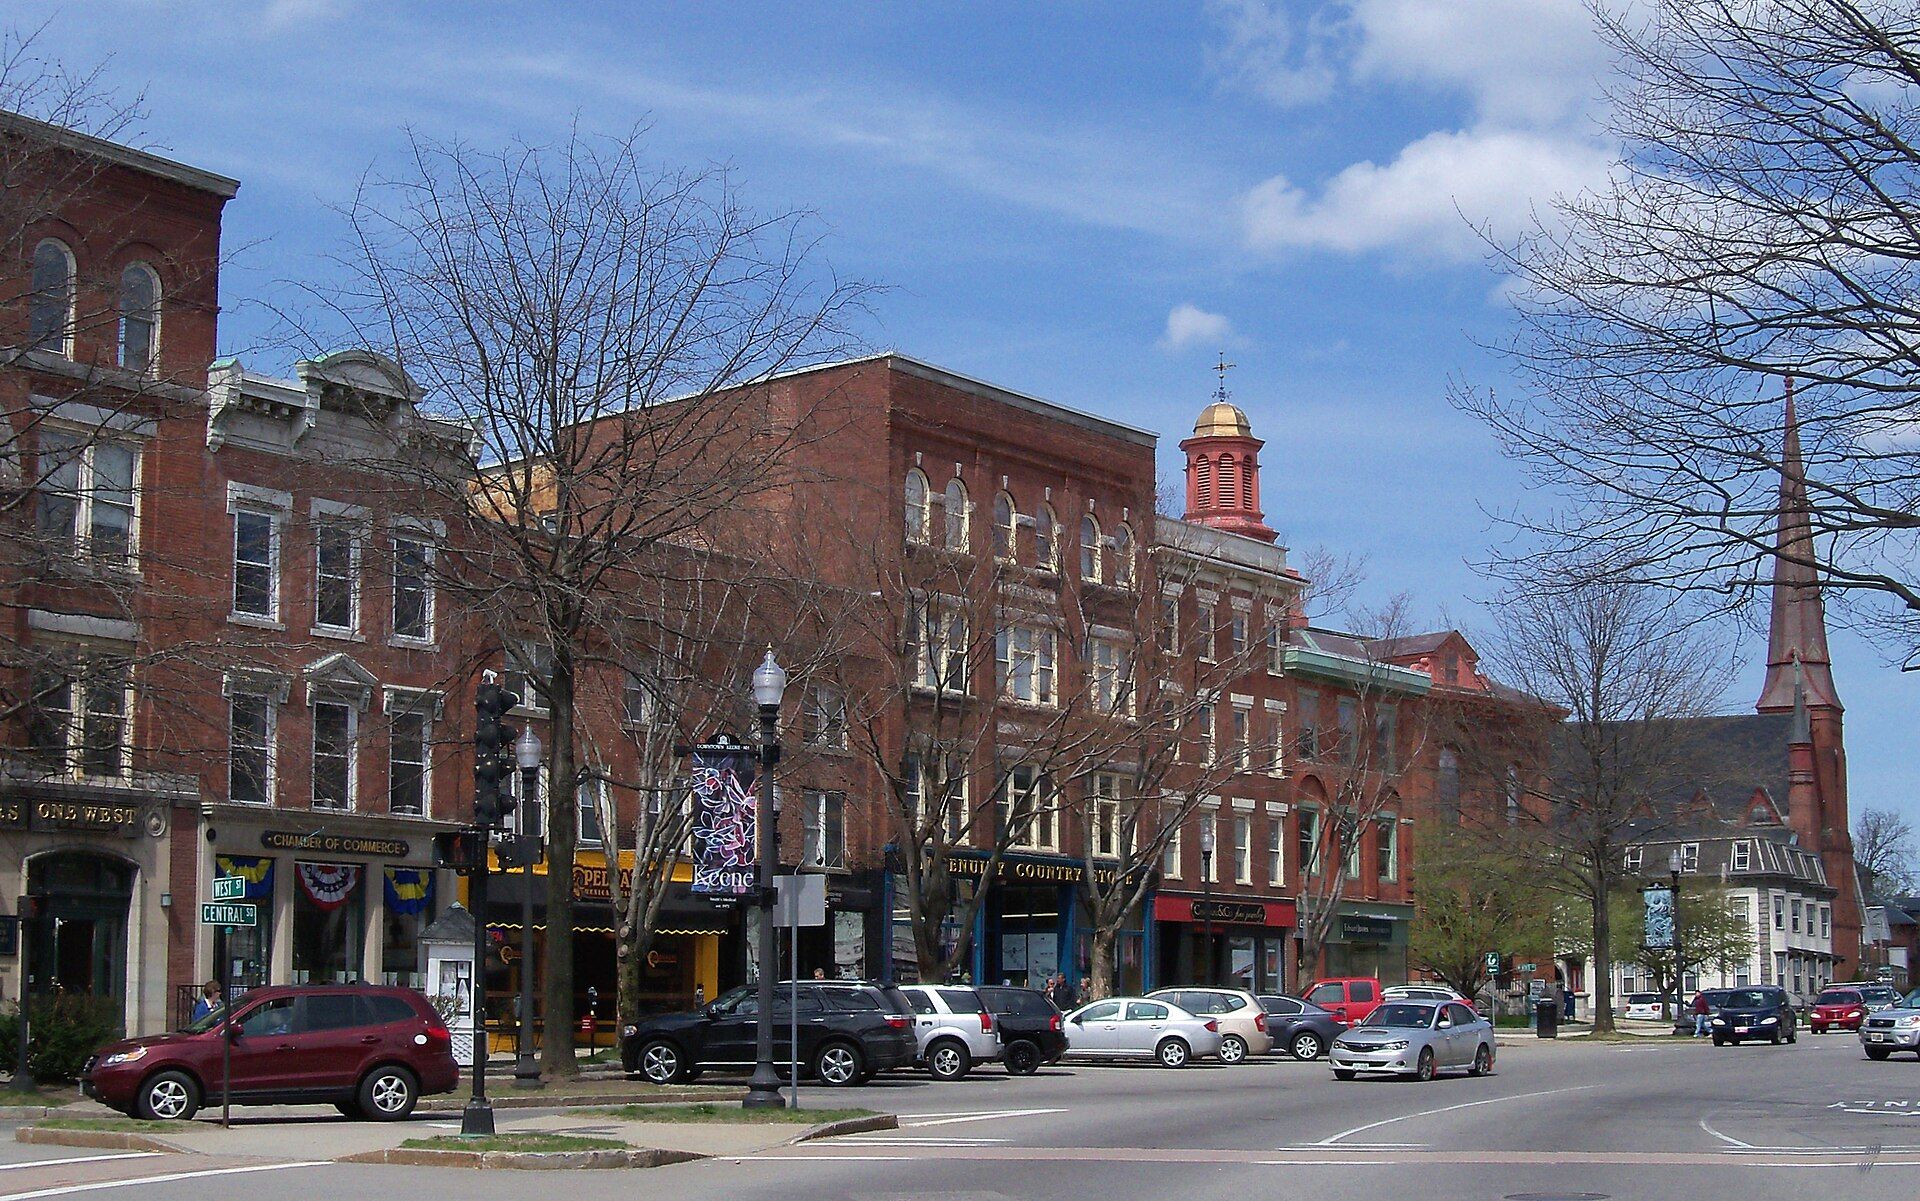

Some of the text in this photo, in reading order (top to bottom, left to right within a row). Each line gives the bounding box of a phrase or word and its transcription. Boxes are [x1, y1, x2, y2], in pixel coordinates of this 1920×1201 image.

[38, 803, 137, 825] ONE WEST
[273, 834, 400, 854] CHAMBER OF COMMERCE
[693, 864, 754, 887] Keene
[1016, 863, 1081, 882] COUNTRY
[214, 881, 232, 897] WEST
[203, 906, 254, 923] CENTRAL SQ
